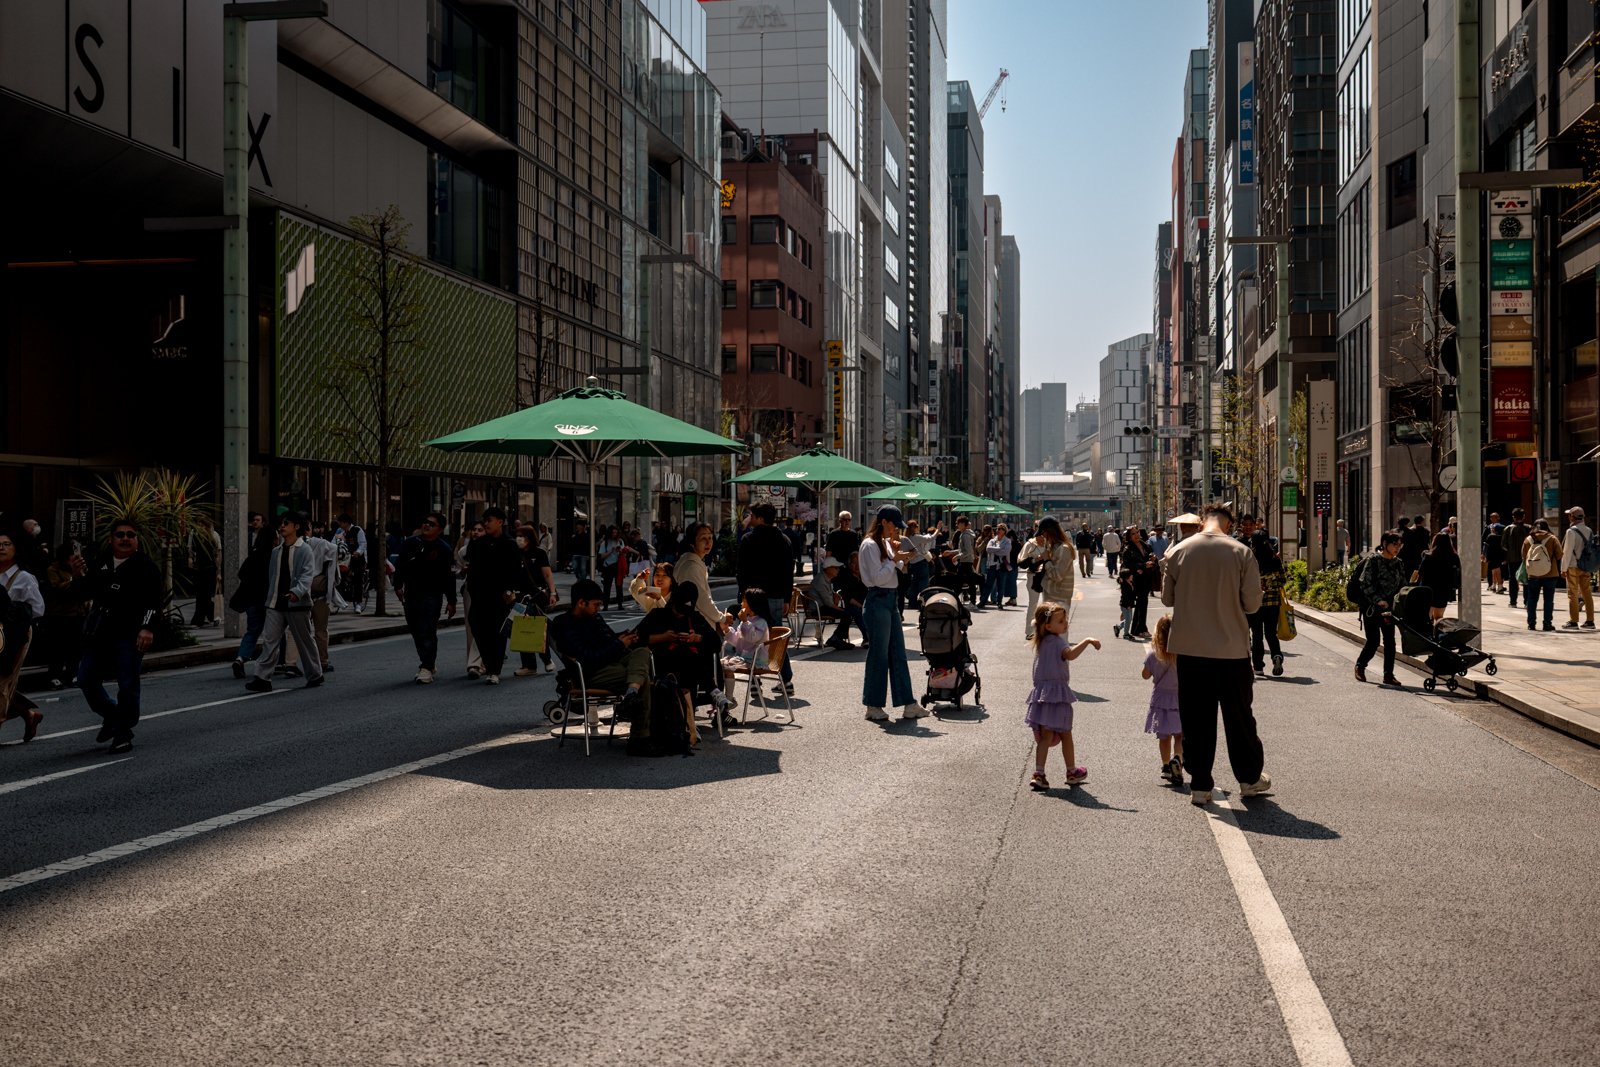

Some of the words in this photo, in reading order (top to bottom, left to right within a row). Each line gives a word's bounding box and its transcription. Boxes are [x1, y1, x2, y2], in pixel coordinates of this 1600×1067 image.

[1241, 98, 1252, 172] 名鉄観光
[1494, 200, 1528, 209] TAT
[548, 263, 599, 309] CELINE
[665, 472, 682, 493] DIOR
